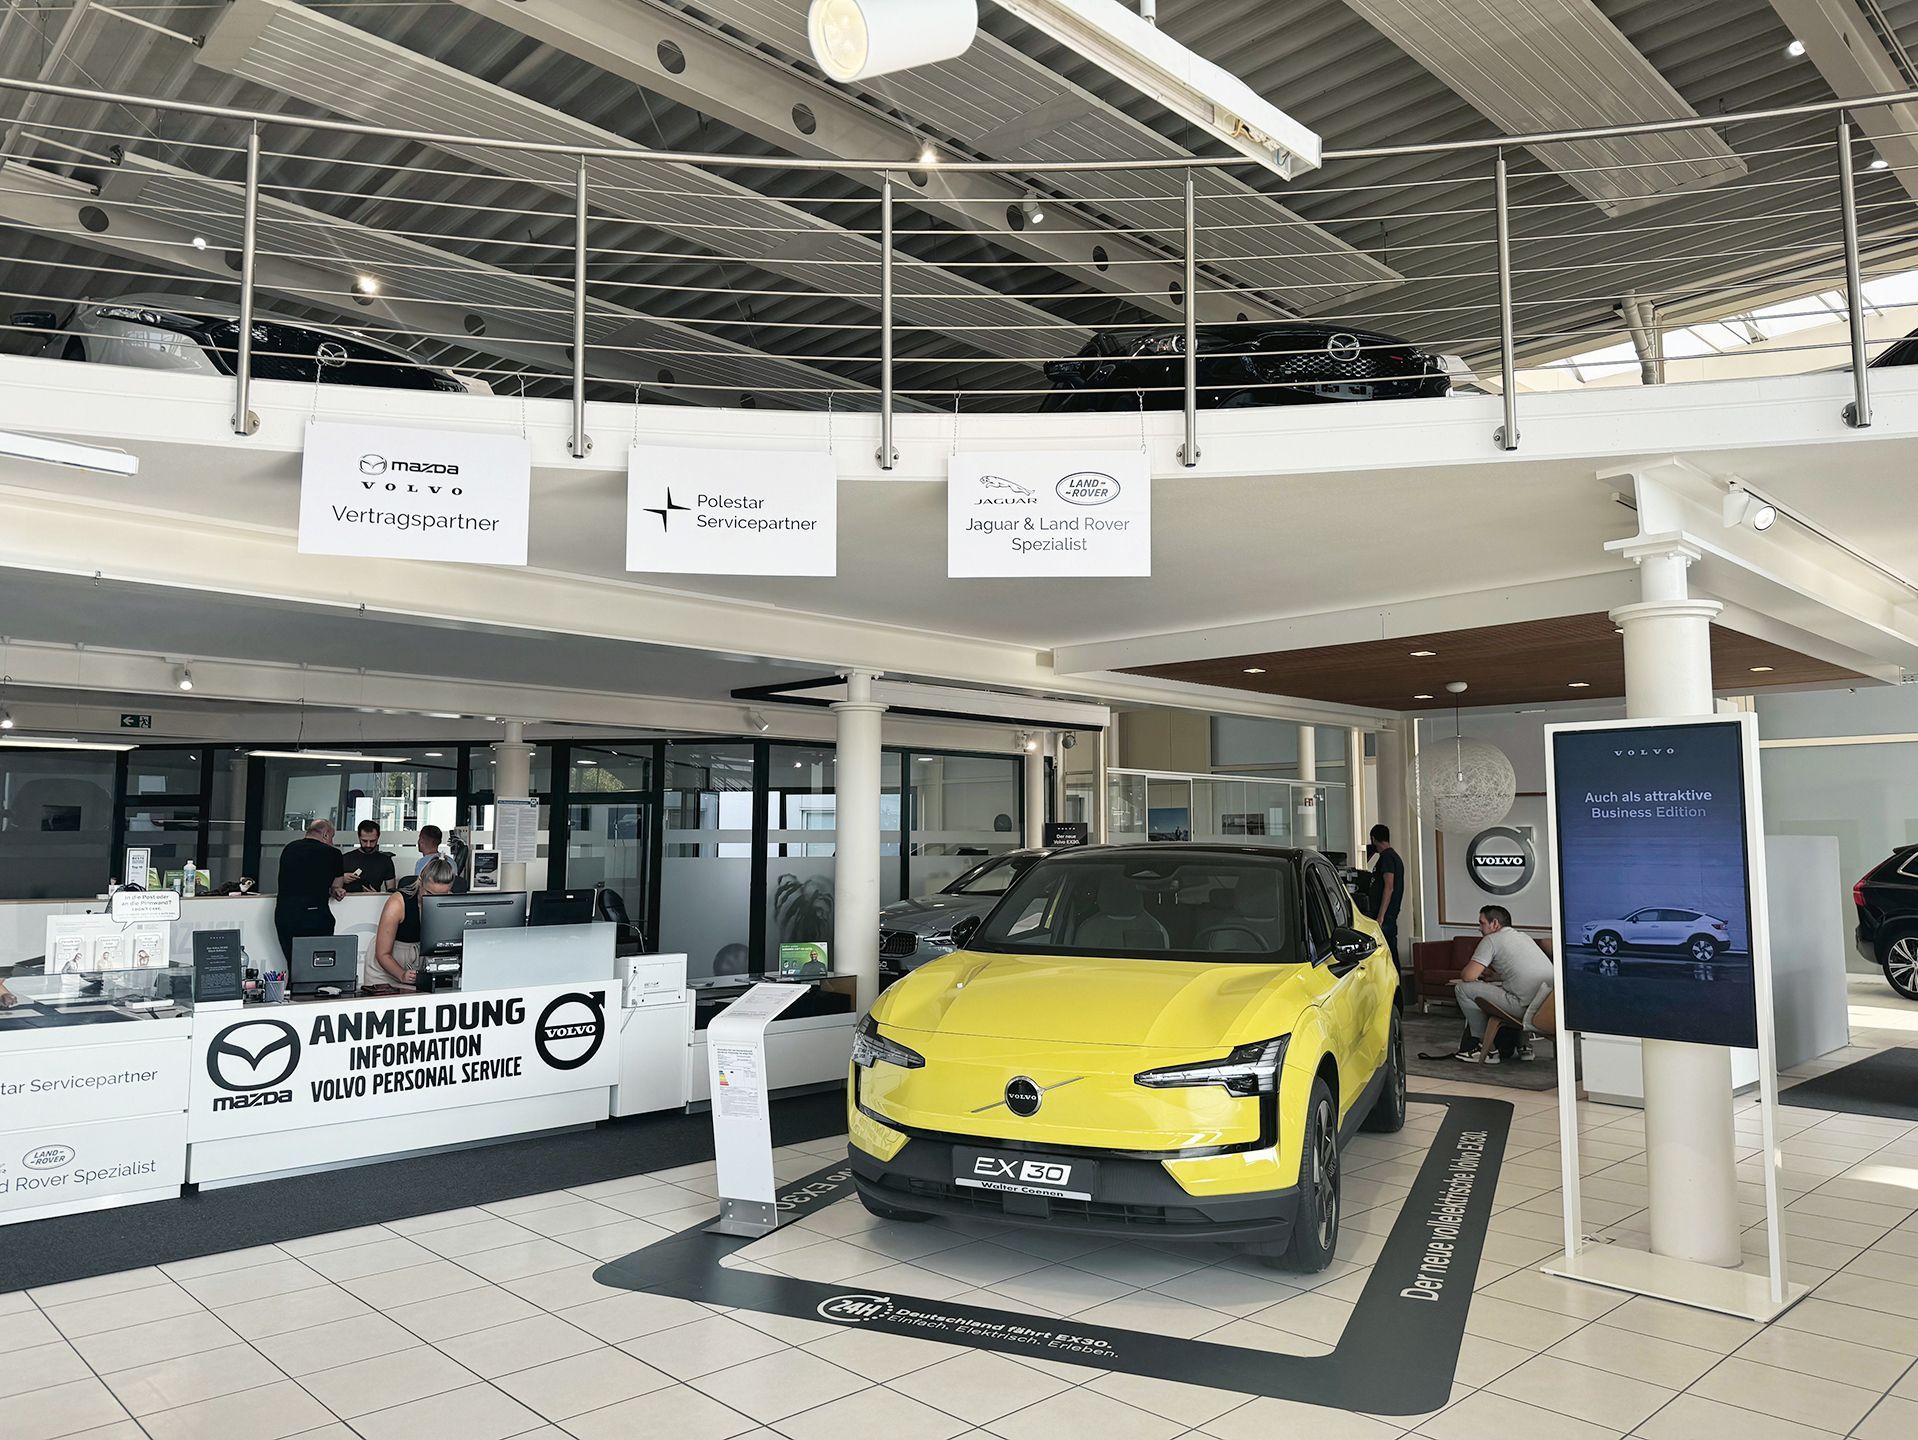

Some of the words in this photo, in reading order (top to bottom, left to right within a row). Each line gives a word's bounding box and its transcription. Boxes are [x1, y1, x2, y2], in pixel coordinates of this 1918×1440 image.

[391, 461, 459, 475] mazda
[361, 481, 463, 496] VOLVO
[697, 494, 765, 509] Polestar
[974, 497, 1038, 505] JAGUAR
[332, 505, 500, 531] Vertragspartner
[696, 514, 817, 532] Servicepartner
[966, 518, 1020, 534] Jaguar
[1023, 517, 1035, 531] &
[1040, 517, 1079, 531] Land
[1085, 518, 1130, 531] Rover
[1012, 537, 1088, 554] Spezialist
[1614, 747, 1675, 757] VOLVO
[1585, 791, 1618, 803] Auch
[1622, 791, 1641, 802] als
[1644, 789, 1712, 801] attraktive
[1591, 807, 1652, 818] Business
[1656, 806, 1706, 817] Edition
[1475, 856, 1523, 865] VOLVO
[308, 997, 526, 1046] ANMELDUNG
[544, 1024, 596, 1039] VOLVO
[349, 1034, 482, 1071] INFORMATION
[1, 1083, 25, 1095] tar
[30, 1070, 158, 1092] Servicepartner
[310, 1077, 366, 1103] VOLVO
[372, 1067, 456, 1096] PERSONAL
[462, 1056, 522, 1082] SERVICE
[213, 1089, 293, 1112] mazda
[1456, 1130, 1489, 1151] EX30.
[973, 1156, 1019, 1179] EX
[1027, 1164, 1064, 1181] 30
[1449, 1152, 1481, 1172] Volvo
[16, 1174, 69, 1191] Rover
[74, 1160, 156, 1185] Spezialist
[981, 1182, 1018, 1192] Walter
[1021, 1187, 1064, 1197] Coenen
[1426, 1173, 1476, 1240] vollelektrische
[1420, 1242, 1455, 1273] neue
[1400, 1273, 1444, 1301] Der
[828, 1299, 882, 1316] 24H
[887, 1314, 949, 1330] Einfach.
[955, 1325, 1041, 1345] Elektrisch.
[1048, 1340, 1119, 1358] Erleben.
[896, 1309, 1005, 1331] Deutschland
[1008, 1326, 1052, 1340] fährt
[1055, 1334, 1113, 1349] EX30.
